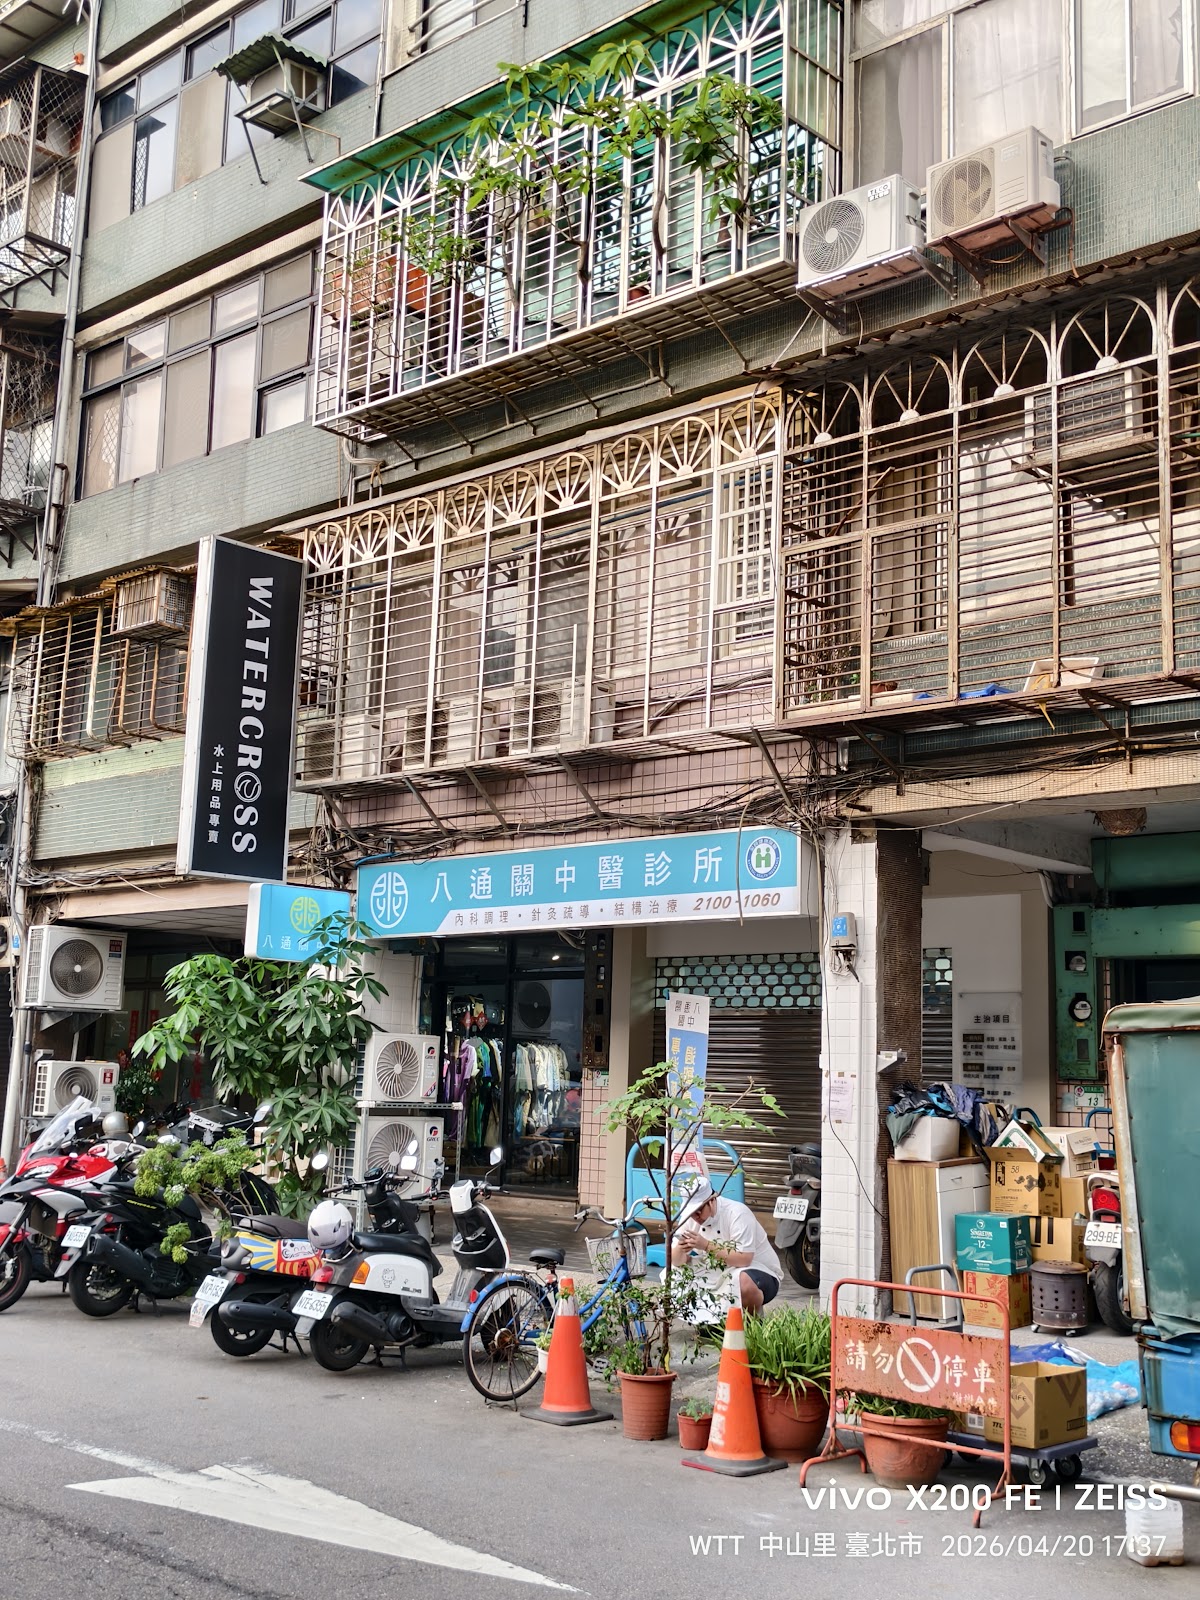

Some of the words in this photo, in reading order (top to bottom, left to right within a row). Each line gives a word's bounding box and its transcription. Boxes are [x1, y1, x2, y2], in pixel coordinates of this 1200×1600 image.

[232, 577, 273, 853] WATERCROSS
[207, 744, 225, 844] 水上用品專賣
[430, 845, 722, 903] 八通關中醫診所
[693, 892, 781, 911] 2100-1060
[974, 1014, 1010, 1024] 主治項目
[1087, 1096, 1099, 1106] 13
[1010, 1165, 1020, 1174] 58
[977, 1240, 986, 1249] 12
[845, 1339, 894, 1374] 請勿
[942, 1354, 996, 1393] 停車
